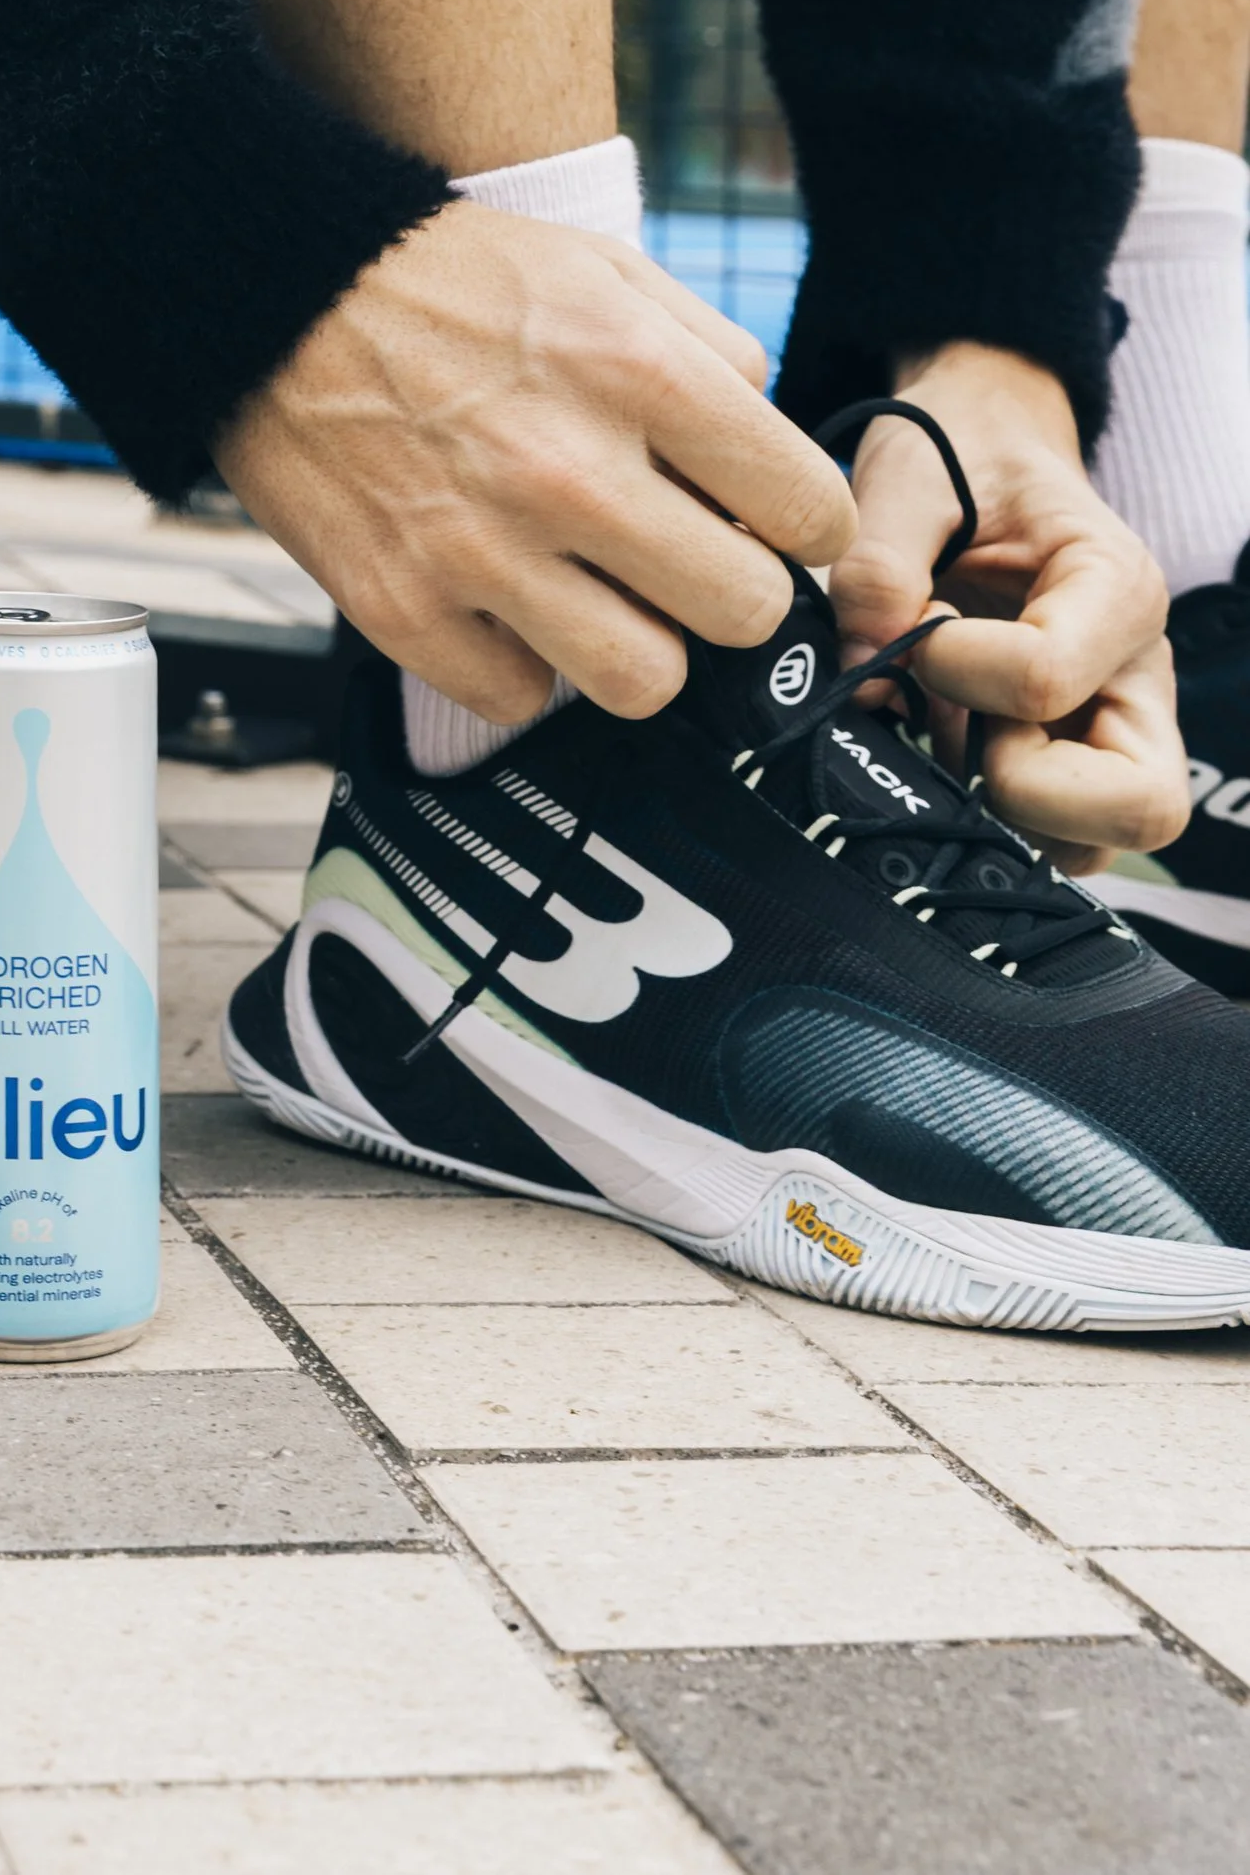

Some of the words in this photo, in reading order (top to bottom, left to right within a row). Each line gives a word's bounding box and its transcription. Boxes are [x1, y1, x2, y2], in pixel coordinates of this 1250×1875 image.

[55, 642, 118, 659] CALORIES
[27, 1018, 90, 1036] WATER
[4, 1076, 146, 1160] lieu
[40, 1191, 64, 1206] pH
[62, 1203, 79, 1217] of
[10, 1217, 55, 1244] 8.2
[786, 1198, 863, 1267] vibram
[14, 1252, 77, 1268] naturally
[21, 1267, 103, 1285] electrolytes
[42, 1285, 101, 1301] minerals
